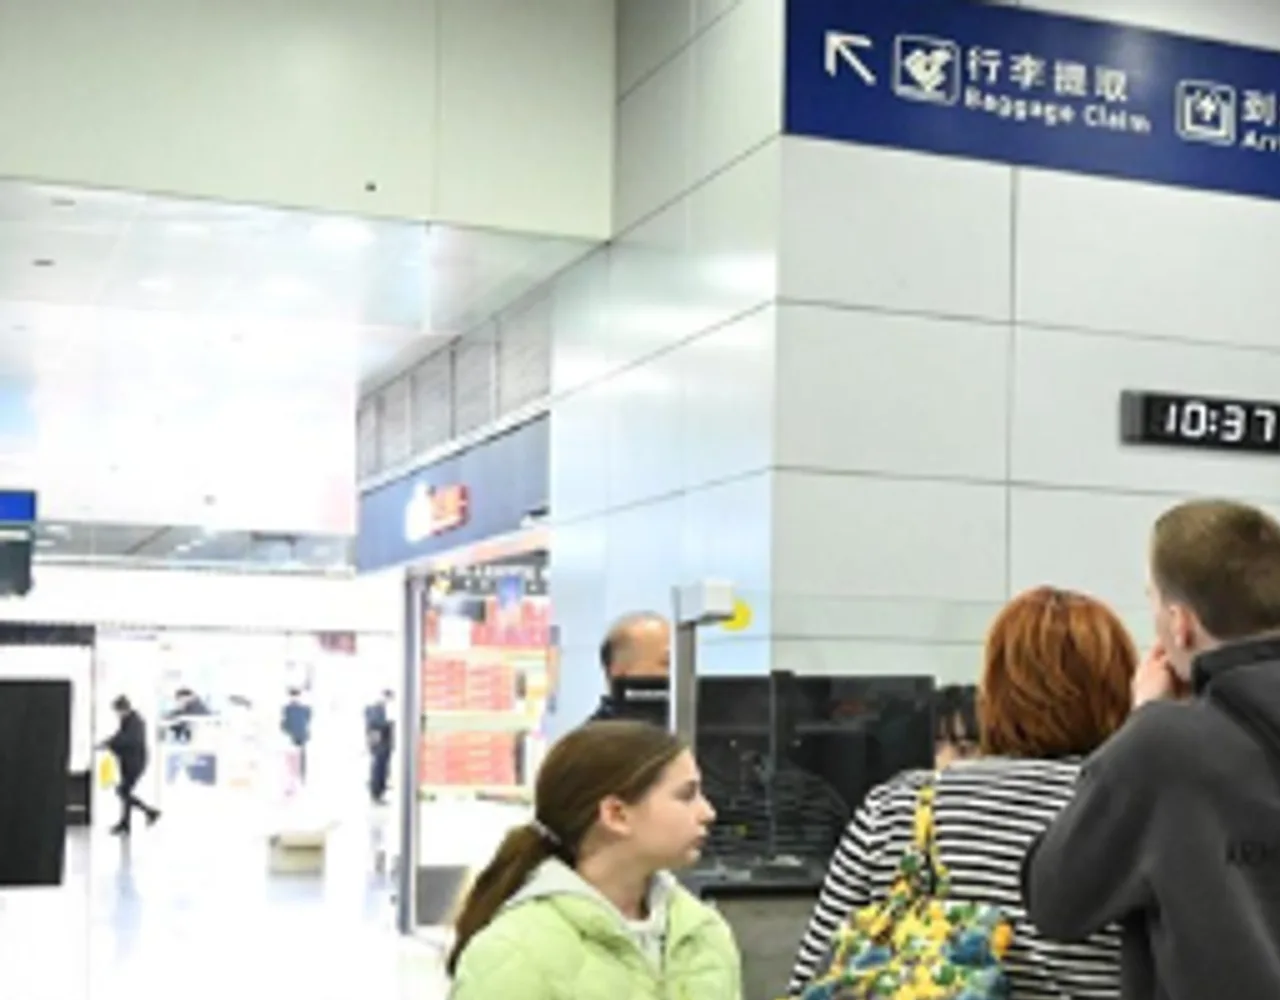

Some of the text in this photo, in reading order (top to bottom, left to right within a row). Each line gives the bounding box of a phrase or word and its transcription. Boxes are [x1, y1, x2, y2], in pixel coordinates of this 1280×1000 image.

[967, 46, 1129, 102] 行李提取
[964, 86, 1152, 132] Baggage Claim
[1164, 401, 1278, 442] 10:37
